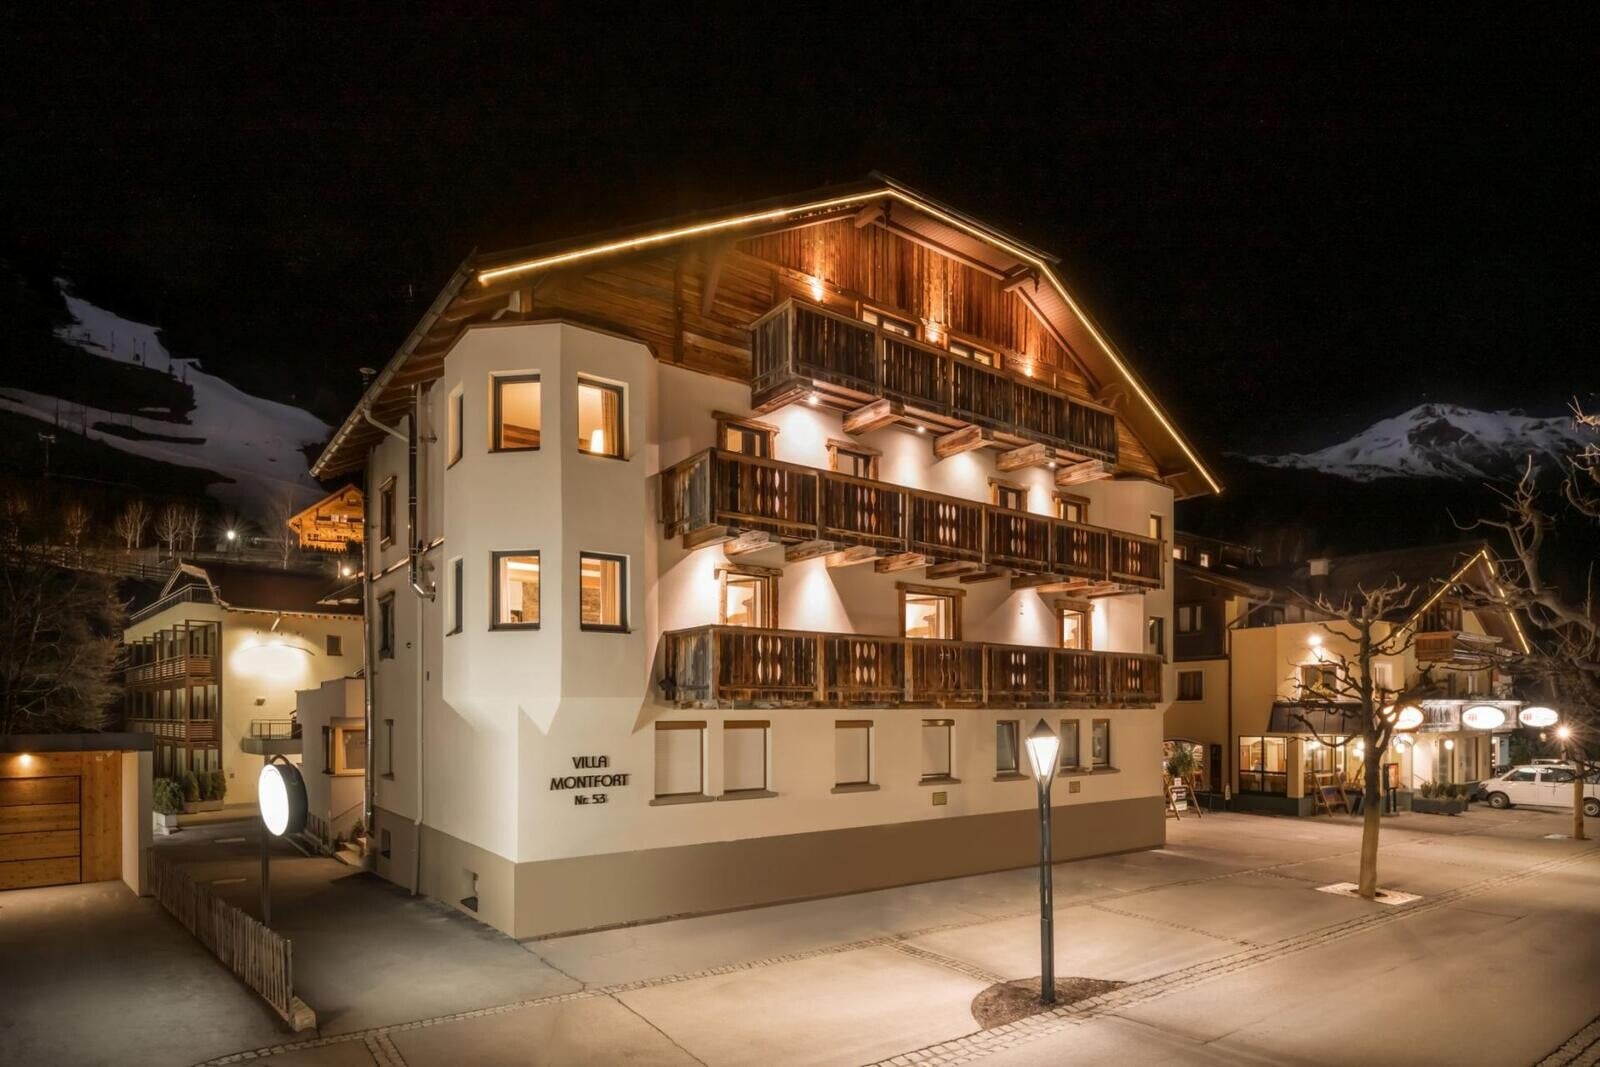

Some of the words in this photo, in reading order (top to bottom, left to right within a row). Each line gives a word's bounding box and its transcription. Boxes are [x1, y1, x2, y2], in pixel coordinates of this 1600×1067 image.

[572, 755, 608, 769] VILLA
[550, 773, 631, 791] MONTFORT
[591, 793, 606, 804] 53
